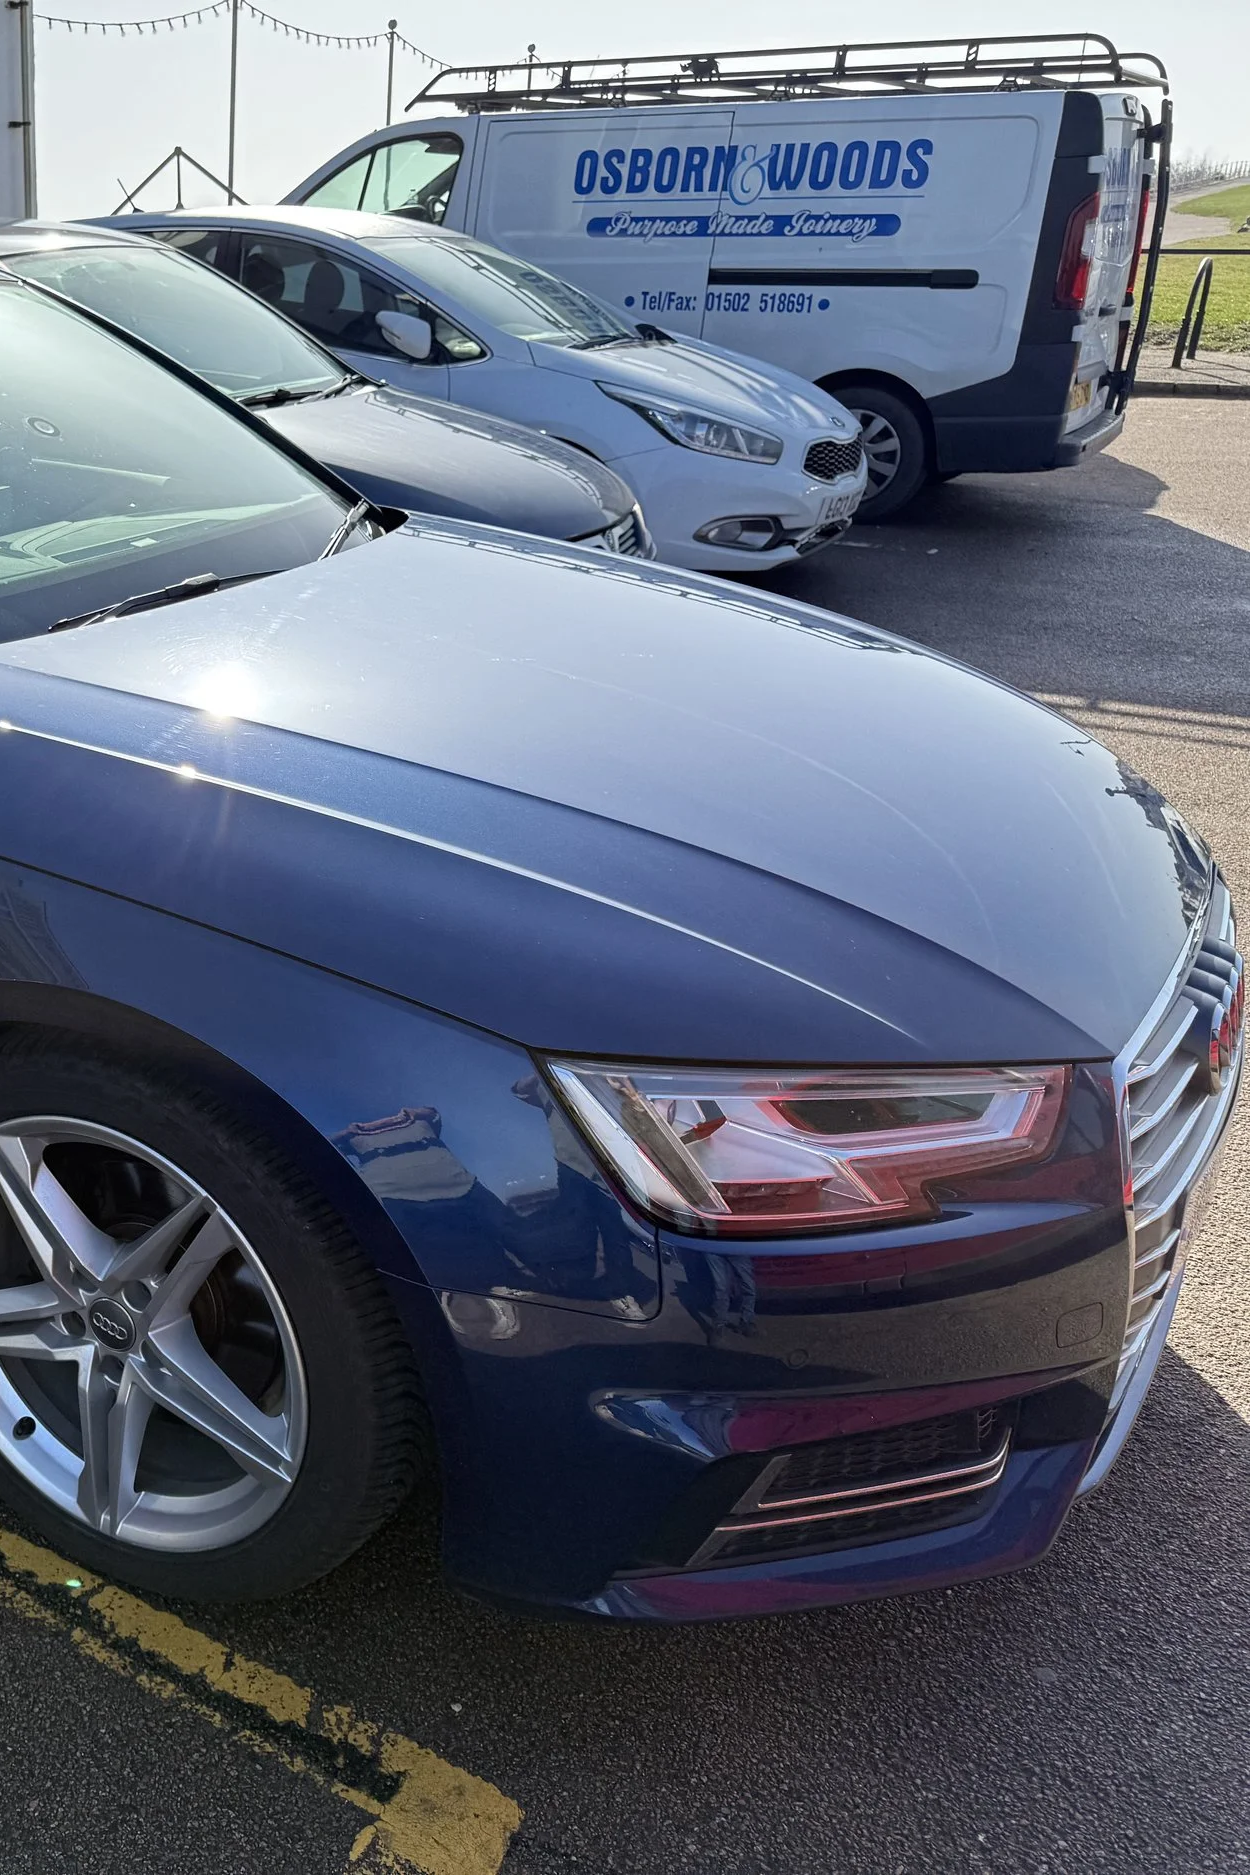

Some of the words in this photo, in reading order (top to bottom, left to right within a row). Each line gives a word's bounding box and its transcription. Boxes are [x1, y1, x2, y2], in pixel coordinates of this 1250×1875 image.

[605, 210, 699, 244] Purpose
[707, 210, 775, 236] Made
[783, 209, 878, 243] Joinery
[641, 291, 697, 312] Tel/Fax:
[704, 291, 751, 312] 01502
[758, 293, 814, 313] 518691
